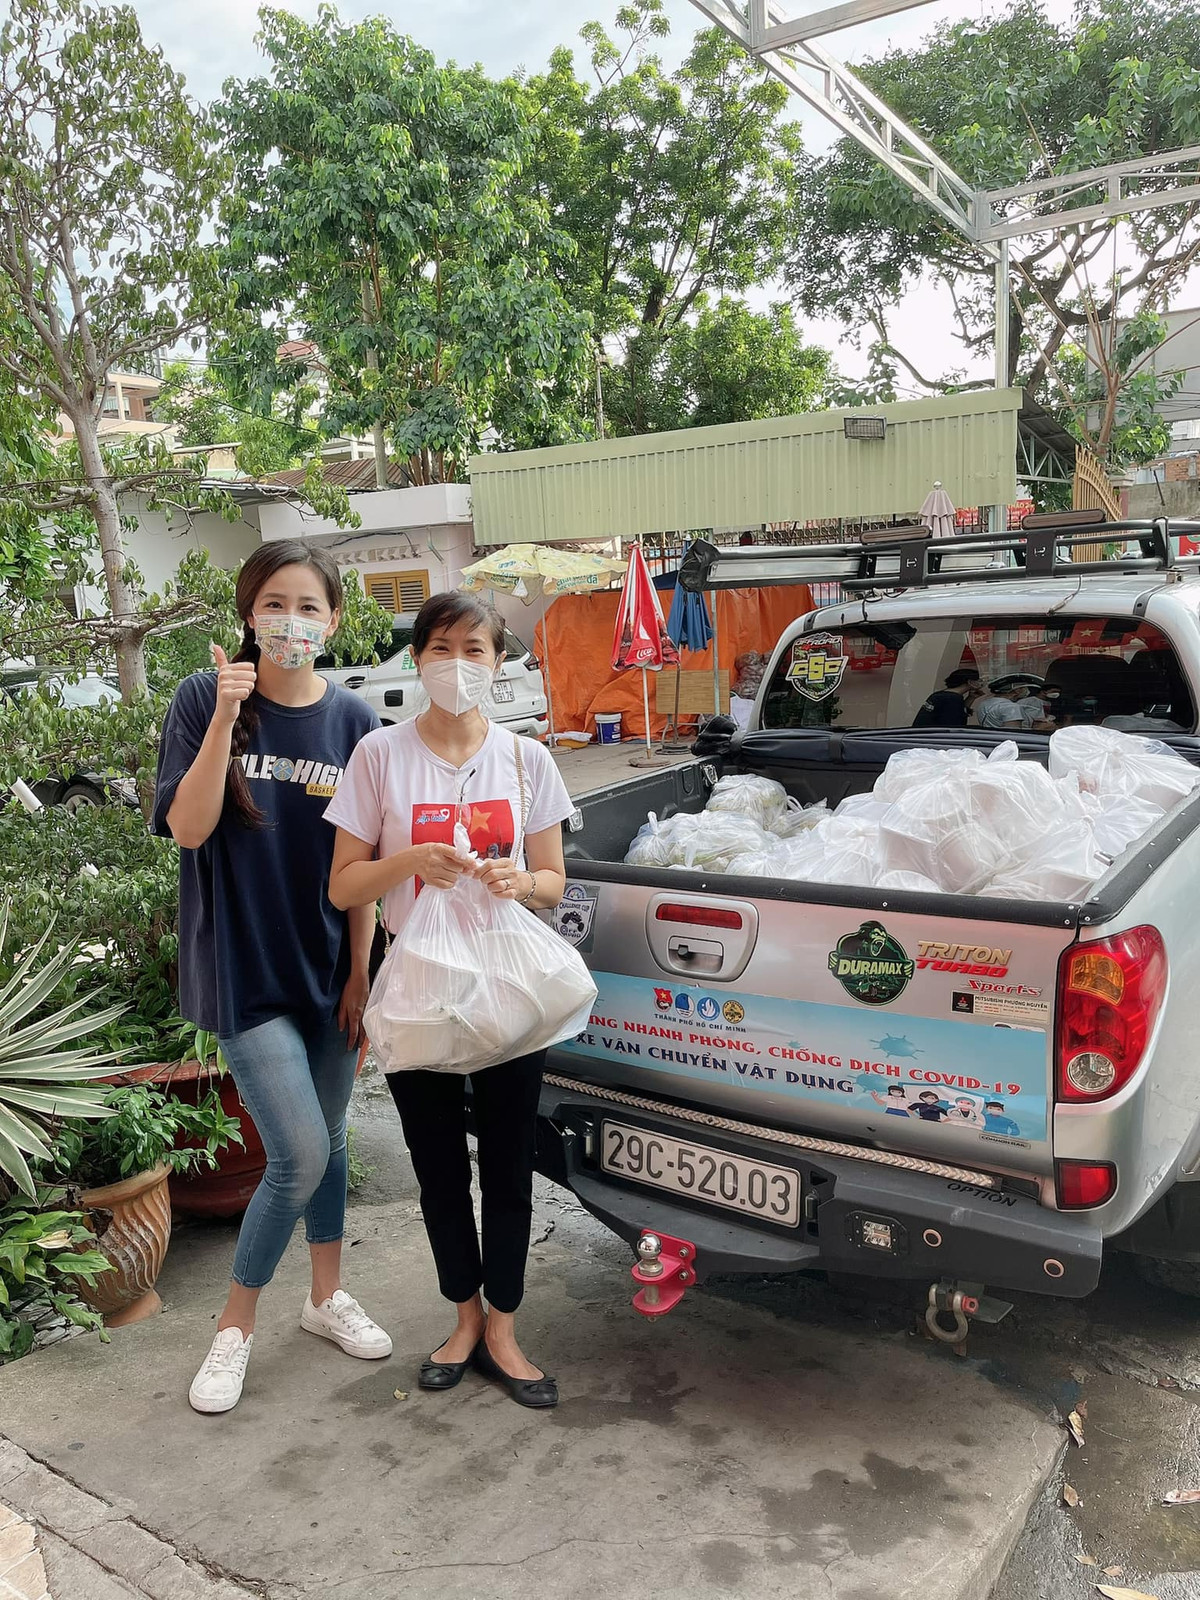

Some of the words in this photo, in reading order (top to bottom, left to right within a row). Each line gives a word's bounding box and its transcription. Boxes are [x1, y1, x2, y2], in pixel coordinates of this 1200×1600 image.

[242, 754, 277, 780] ILE
[917, 940, 1013, 966] TRITON
[837, 959, 902, 975] DURAMAX
[915, 958, 1009, 978] TURBO
[975, 996, 1004, 1004] MITSUBISHI
[709, 1022, 722, 1030] CHÍ
[576, 1032, 596, 1046] XE
[602, 1036, 641, 1055] VẬN
[648, 1046, 727, 1072] CHUYỂN
[735, 1062, 777, 1080] VẬT
[785, 1070, 854, 1093] DỤNG
[623, 1021, 683, 1042] NHANH
[689, 1033, 762, 1055] PHÒNG,
[768, 1046, 841, 1067] CHỐNG
[850, 1059, 901, 1077] DỊCH
[909, 1069, 1021, 1096] COVID-19
[607, 1130, 791, 1216] 29C-520.03
[947, 1182, 1017, 1207] OPTION
